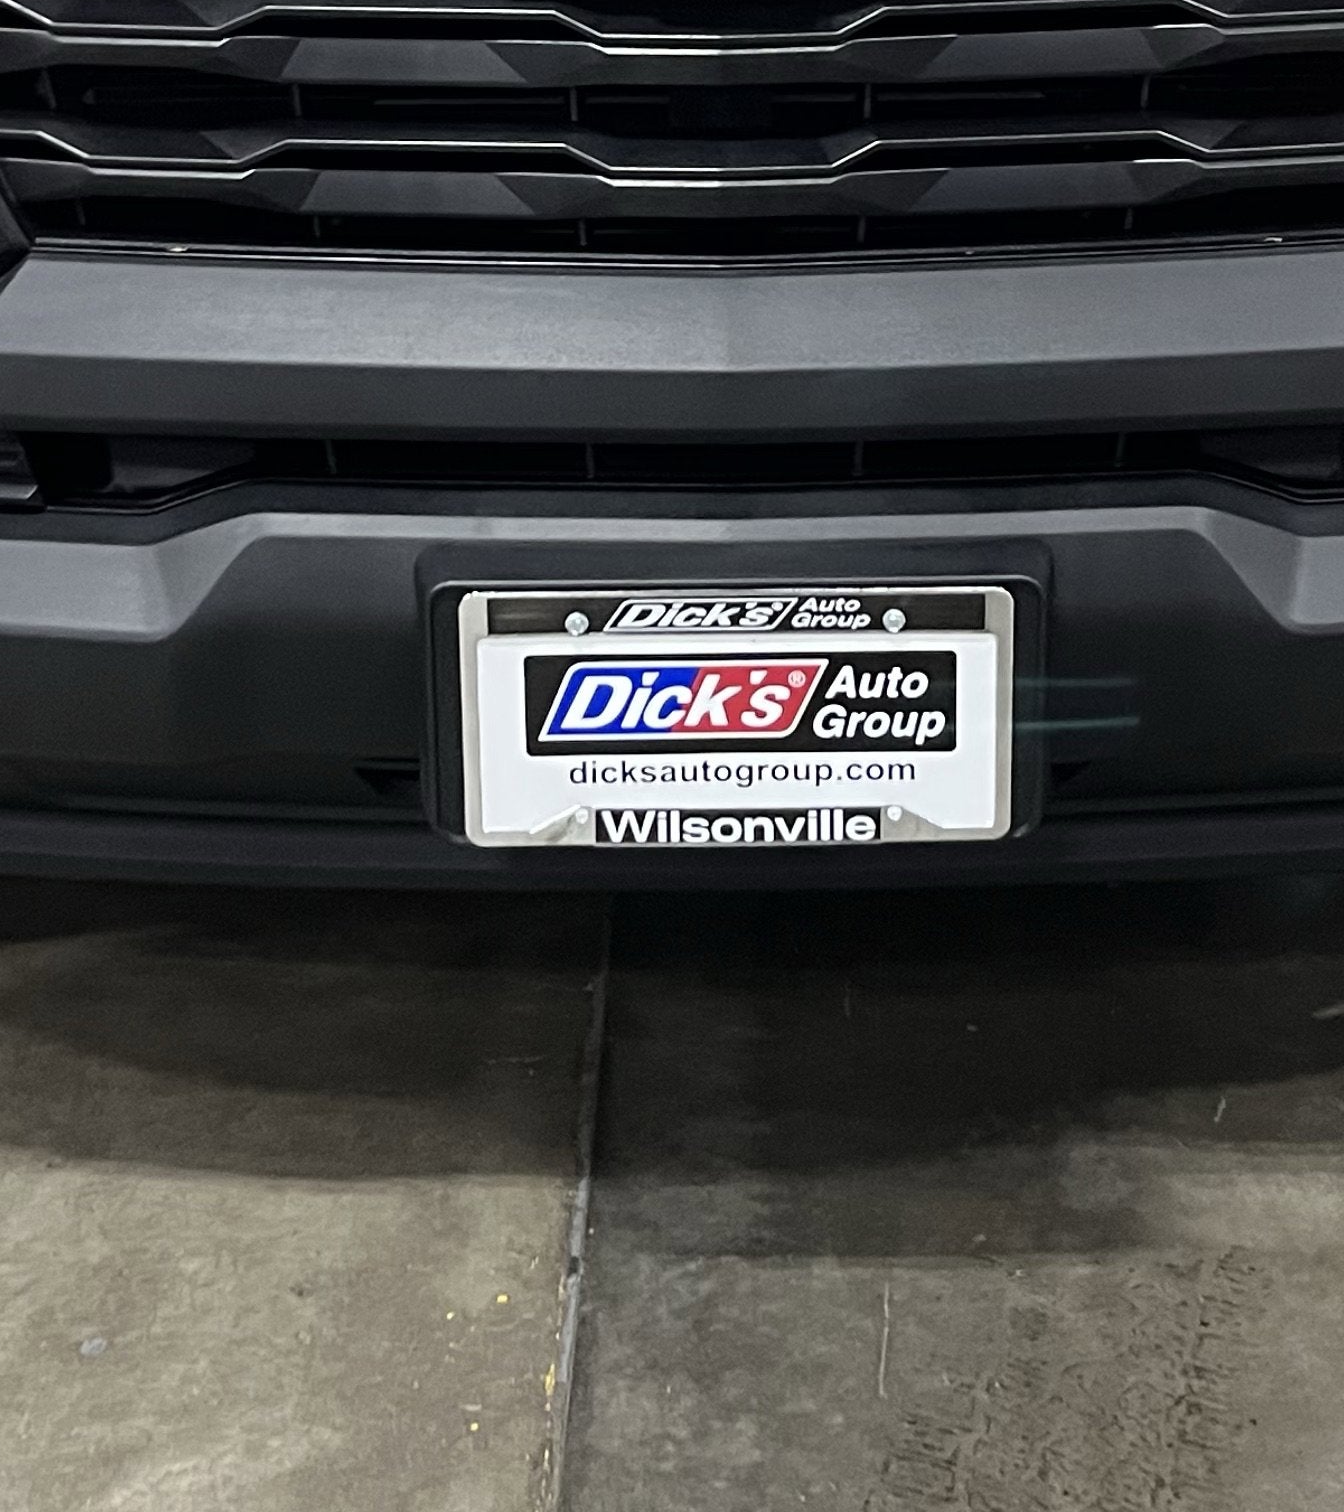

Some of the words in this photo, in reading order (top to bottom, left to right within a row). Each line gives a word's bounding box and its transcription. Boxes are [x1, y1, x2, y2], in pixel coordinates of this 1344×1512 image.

[799, 597, 861, 613] Auto
[791, 612, 872, 630] Group
[826, 664, 929, 699] Auto
[813, 704, 946, 745] Group
[569, 759, 917, 787] dicksautogroup.com
[602, 810, 877, 843] Wilsonville
